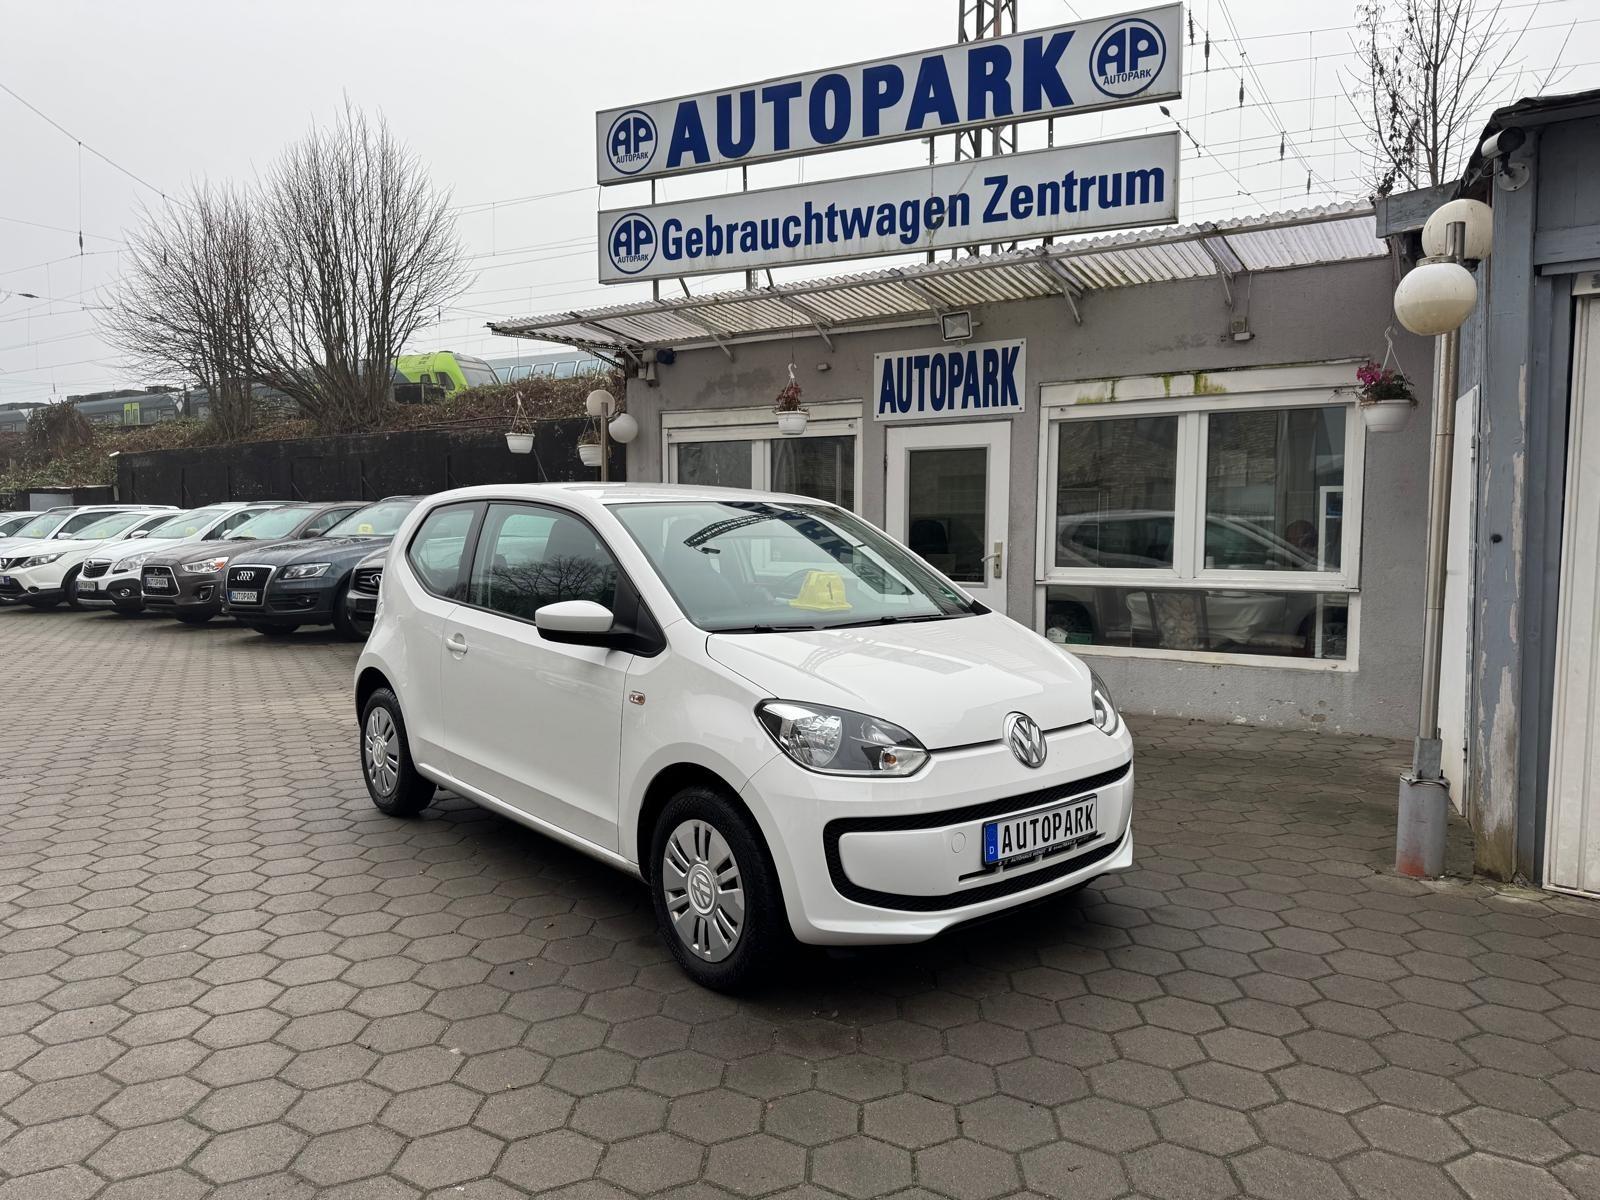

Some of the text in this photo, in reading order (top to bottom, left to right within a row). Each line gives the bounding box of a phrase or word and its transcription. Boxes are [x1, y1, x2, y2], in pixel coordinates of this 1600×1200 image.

[1097, 27, 1159, 77] AP
[1103, 68, 1152, 86] AUTOPARK
[666, 30, 1076, 168] AUTOPARK
[611, 116, 654, 157] AP
[616, 151, 649, 164] AUTOPARK
[662, 167, 1165, 261] Gebrauchtwagen Zentrum
[613, 219, 654, 257] AP
[617, 253, 649, 264] AUTOPARK
[878, 346, 1021, 414] AUTOPARK
[232, 591, 257, 601] AUTOPARK
[989, 846, 995, 855] D
[1001, 803, 1094, 854] AUTOPARK
